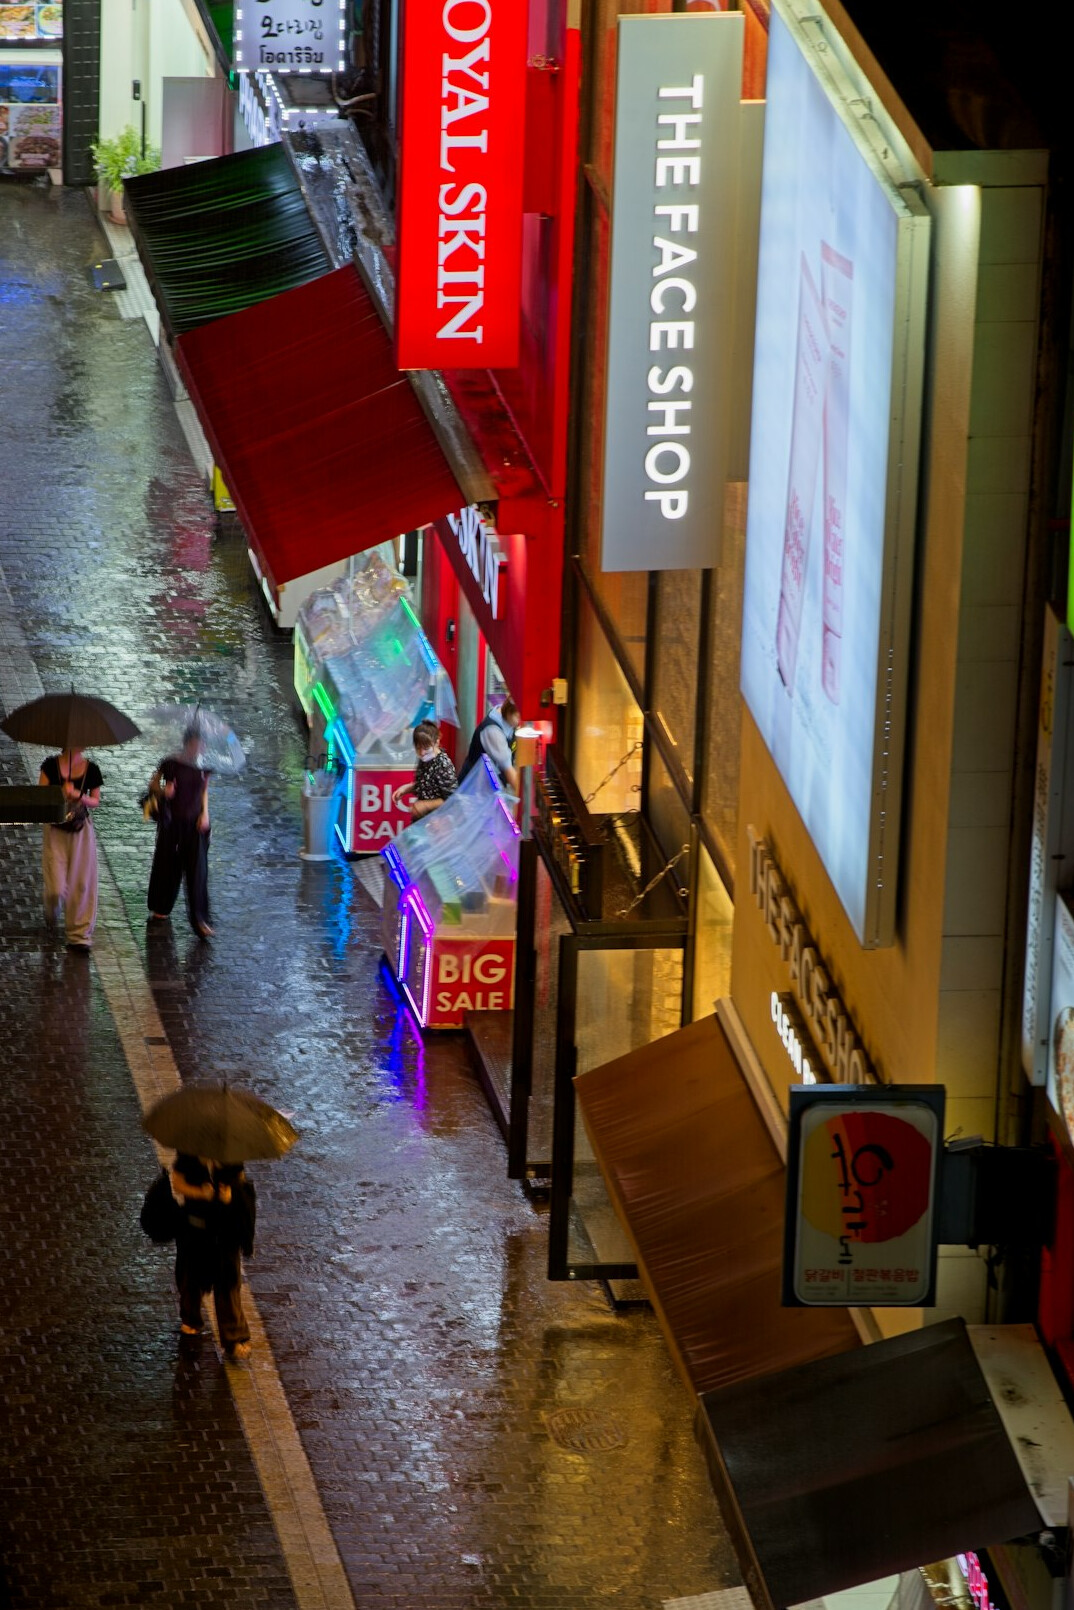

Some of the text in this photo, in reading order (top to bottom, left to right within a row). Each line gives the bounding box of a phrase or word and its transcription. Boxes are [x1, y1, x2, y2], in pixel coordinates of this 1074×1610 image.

[436, 0, 492, 344] OYAL SKIN
[644, 74, 705, 520] THE FACE SHOP
[358, 819, 405, 840] SAL
[438, 953, 507, 984] BIG
[435, 991, 504, 1012] SALE
[825, 997, 878, 1084] SHO
[804, 1268, 844, 1283] 닭갈비
